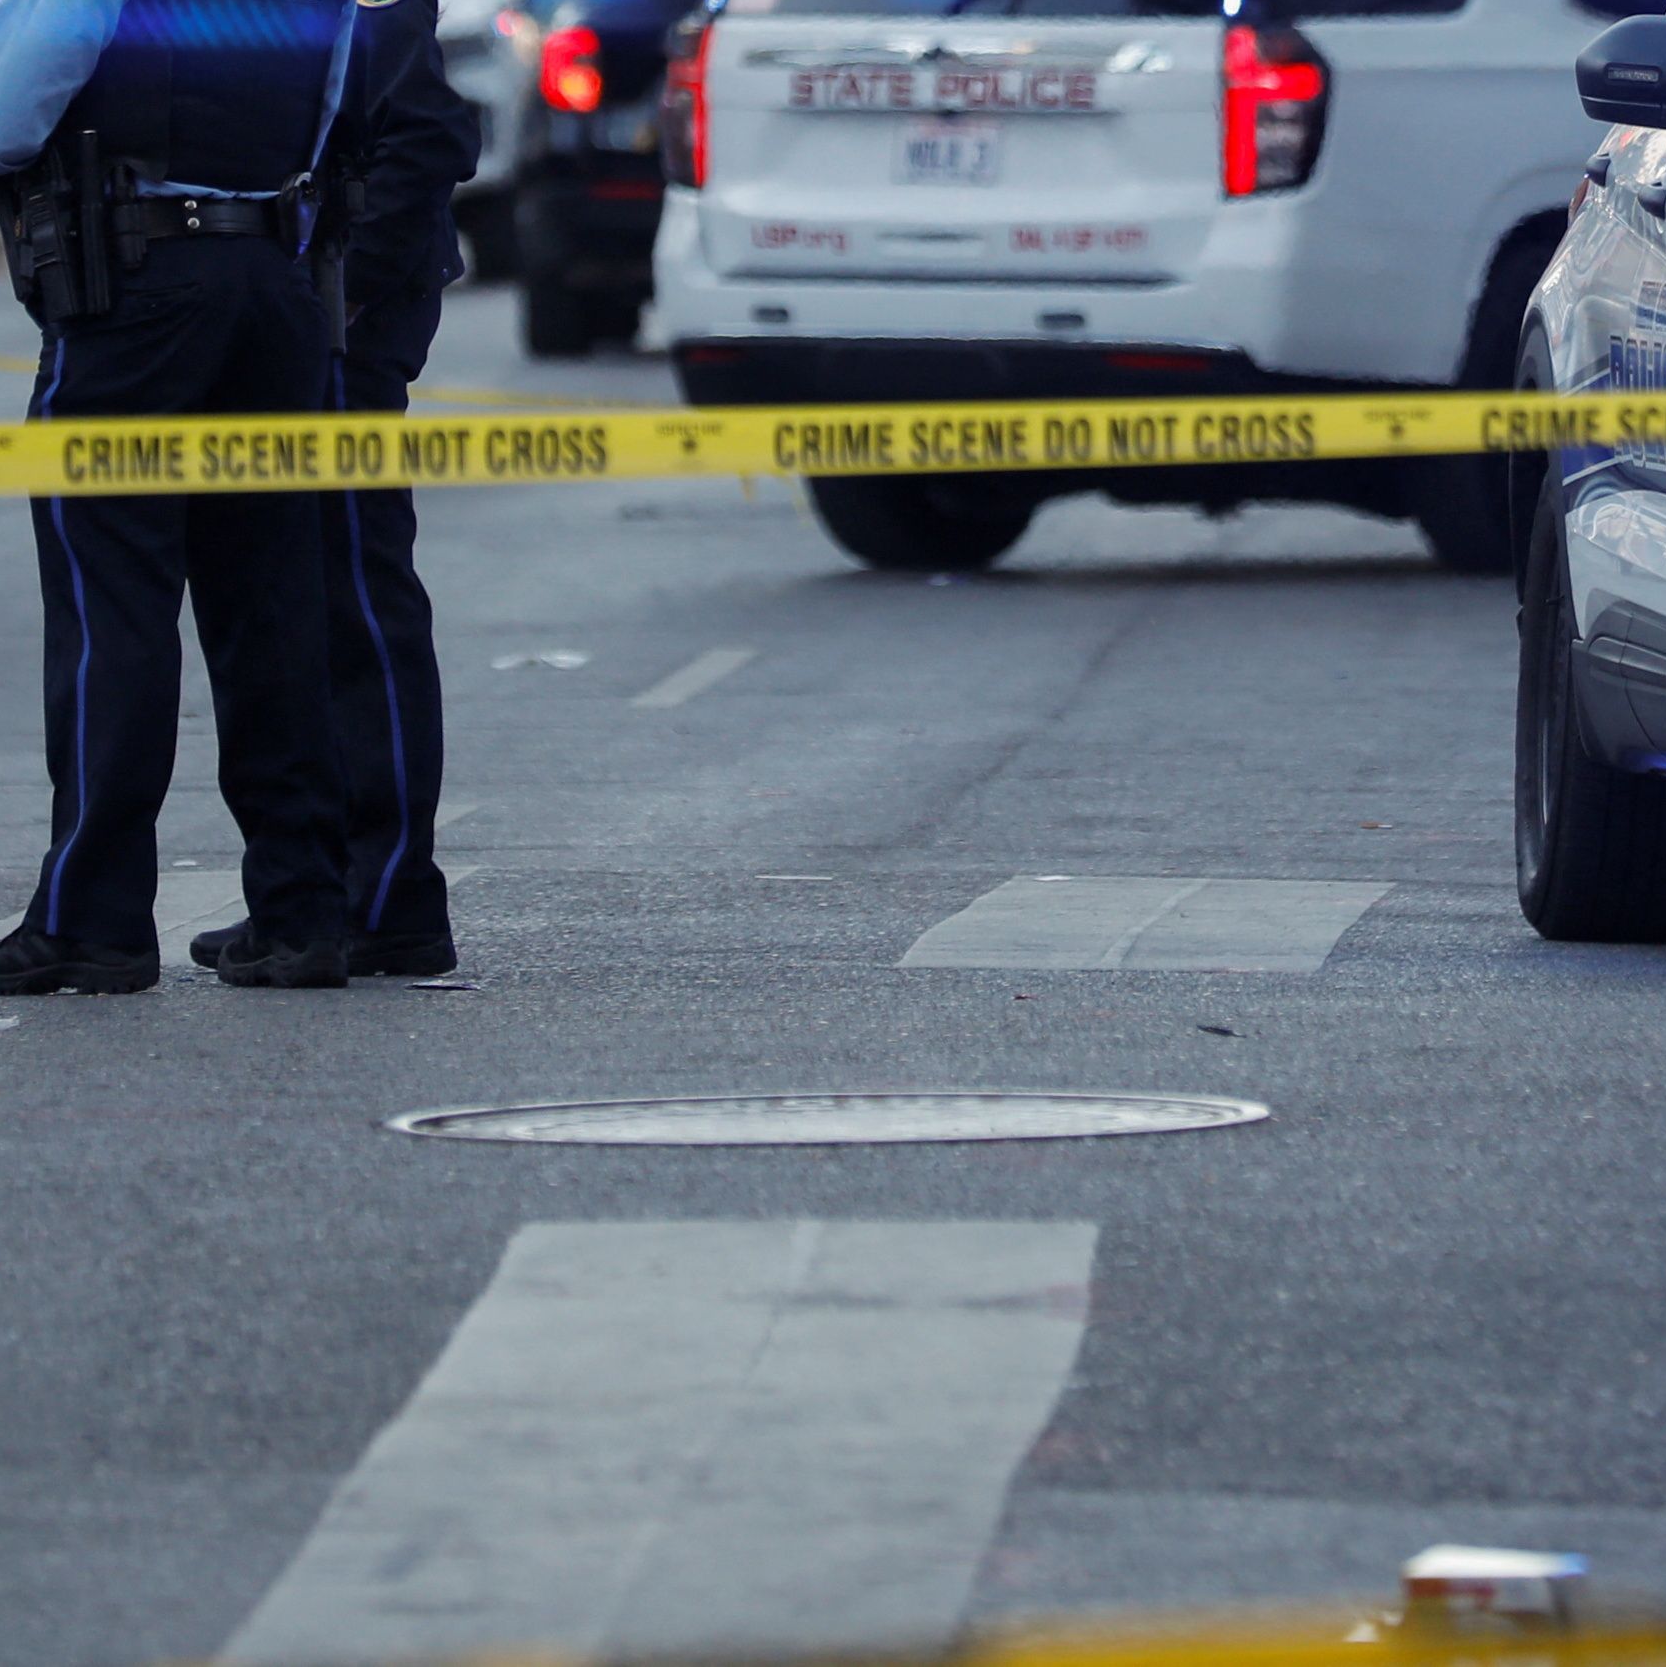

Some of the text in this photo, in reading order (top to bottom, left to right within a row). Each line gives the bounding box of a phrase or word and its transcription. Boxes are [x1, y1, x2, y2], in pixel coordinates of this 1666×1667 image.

[788, 72, 1097, 110] STATE POLICE
[63, 425, 608, 483] CRIME SCENE DO NOT CROSS
[773, 413, 1317, 470] CRIME SCENE DO NOT CROSS
[1481, 407, 1601, 451] CRIME
